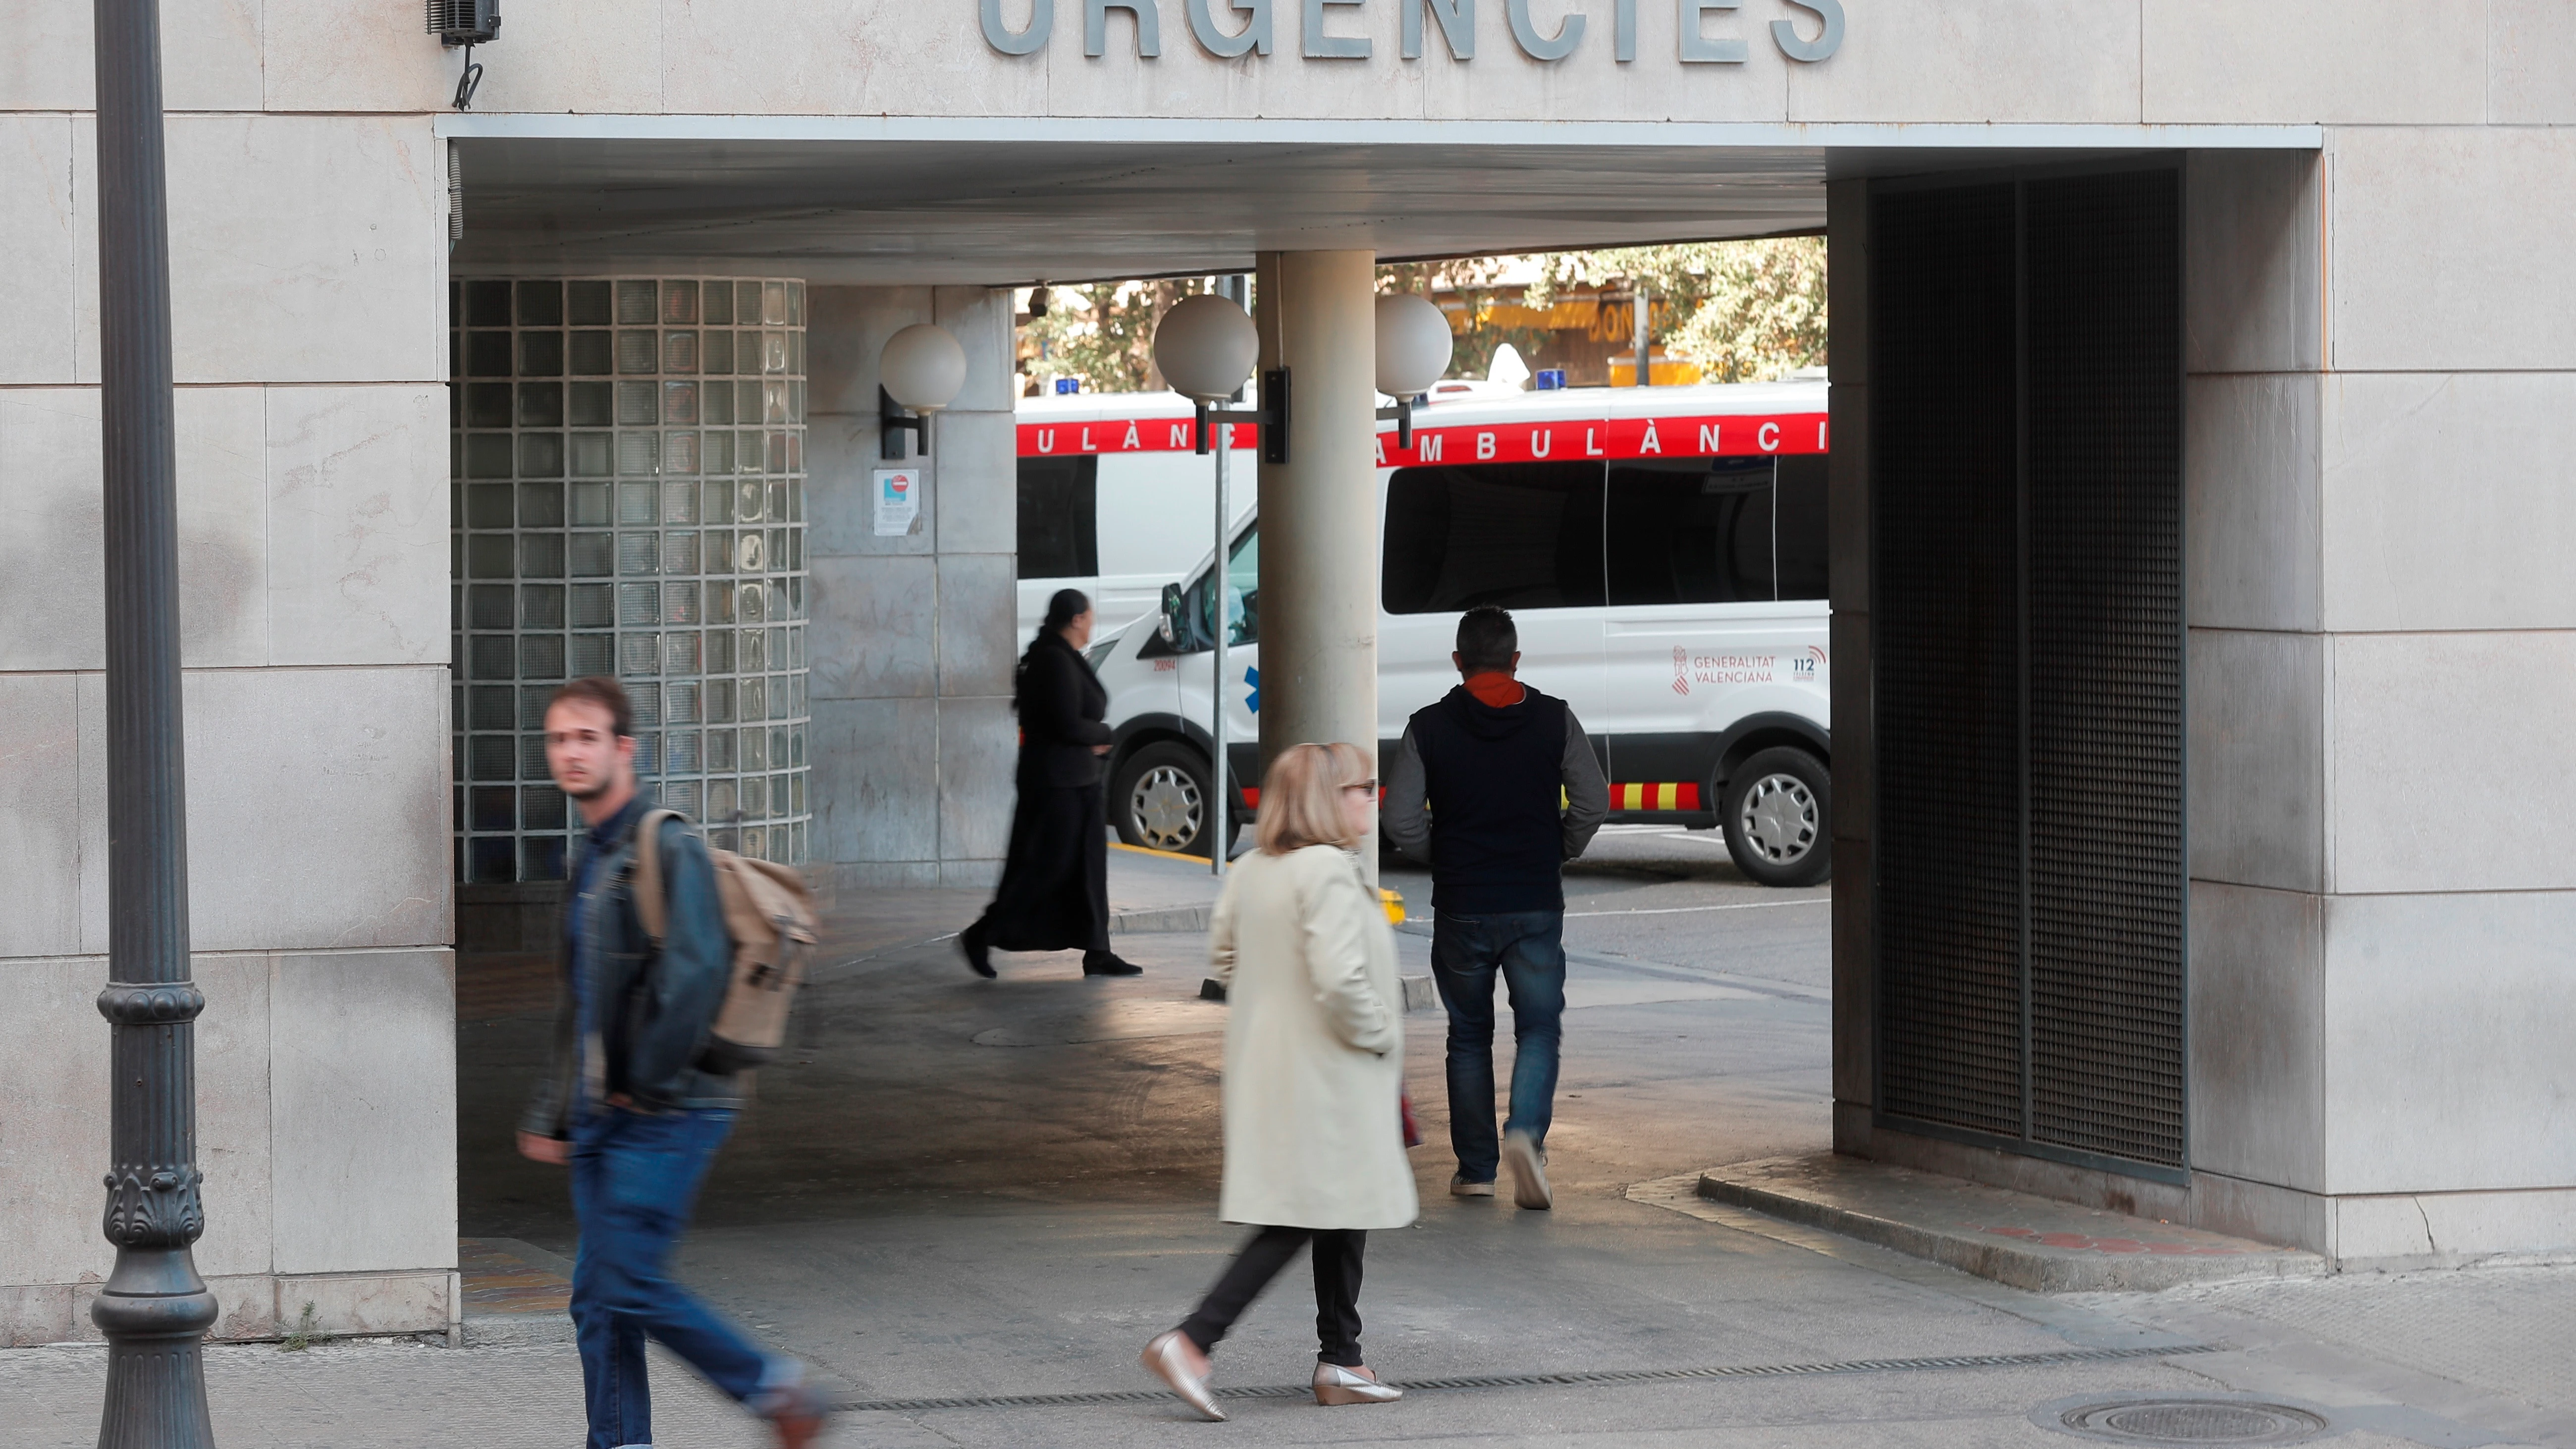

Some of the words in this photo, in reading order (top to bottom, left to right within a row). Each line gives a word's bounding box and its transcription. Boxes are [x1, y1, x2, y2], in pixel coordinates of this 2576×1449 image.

[1694, 656, 1775, 668] GENERALITAT
[1794, 658, 1815, 671] 112
[1695, 671, 1773, 683] VALENCIANA
